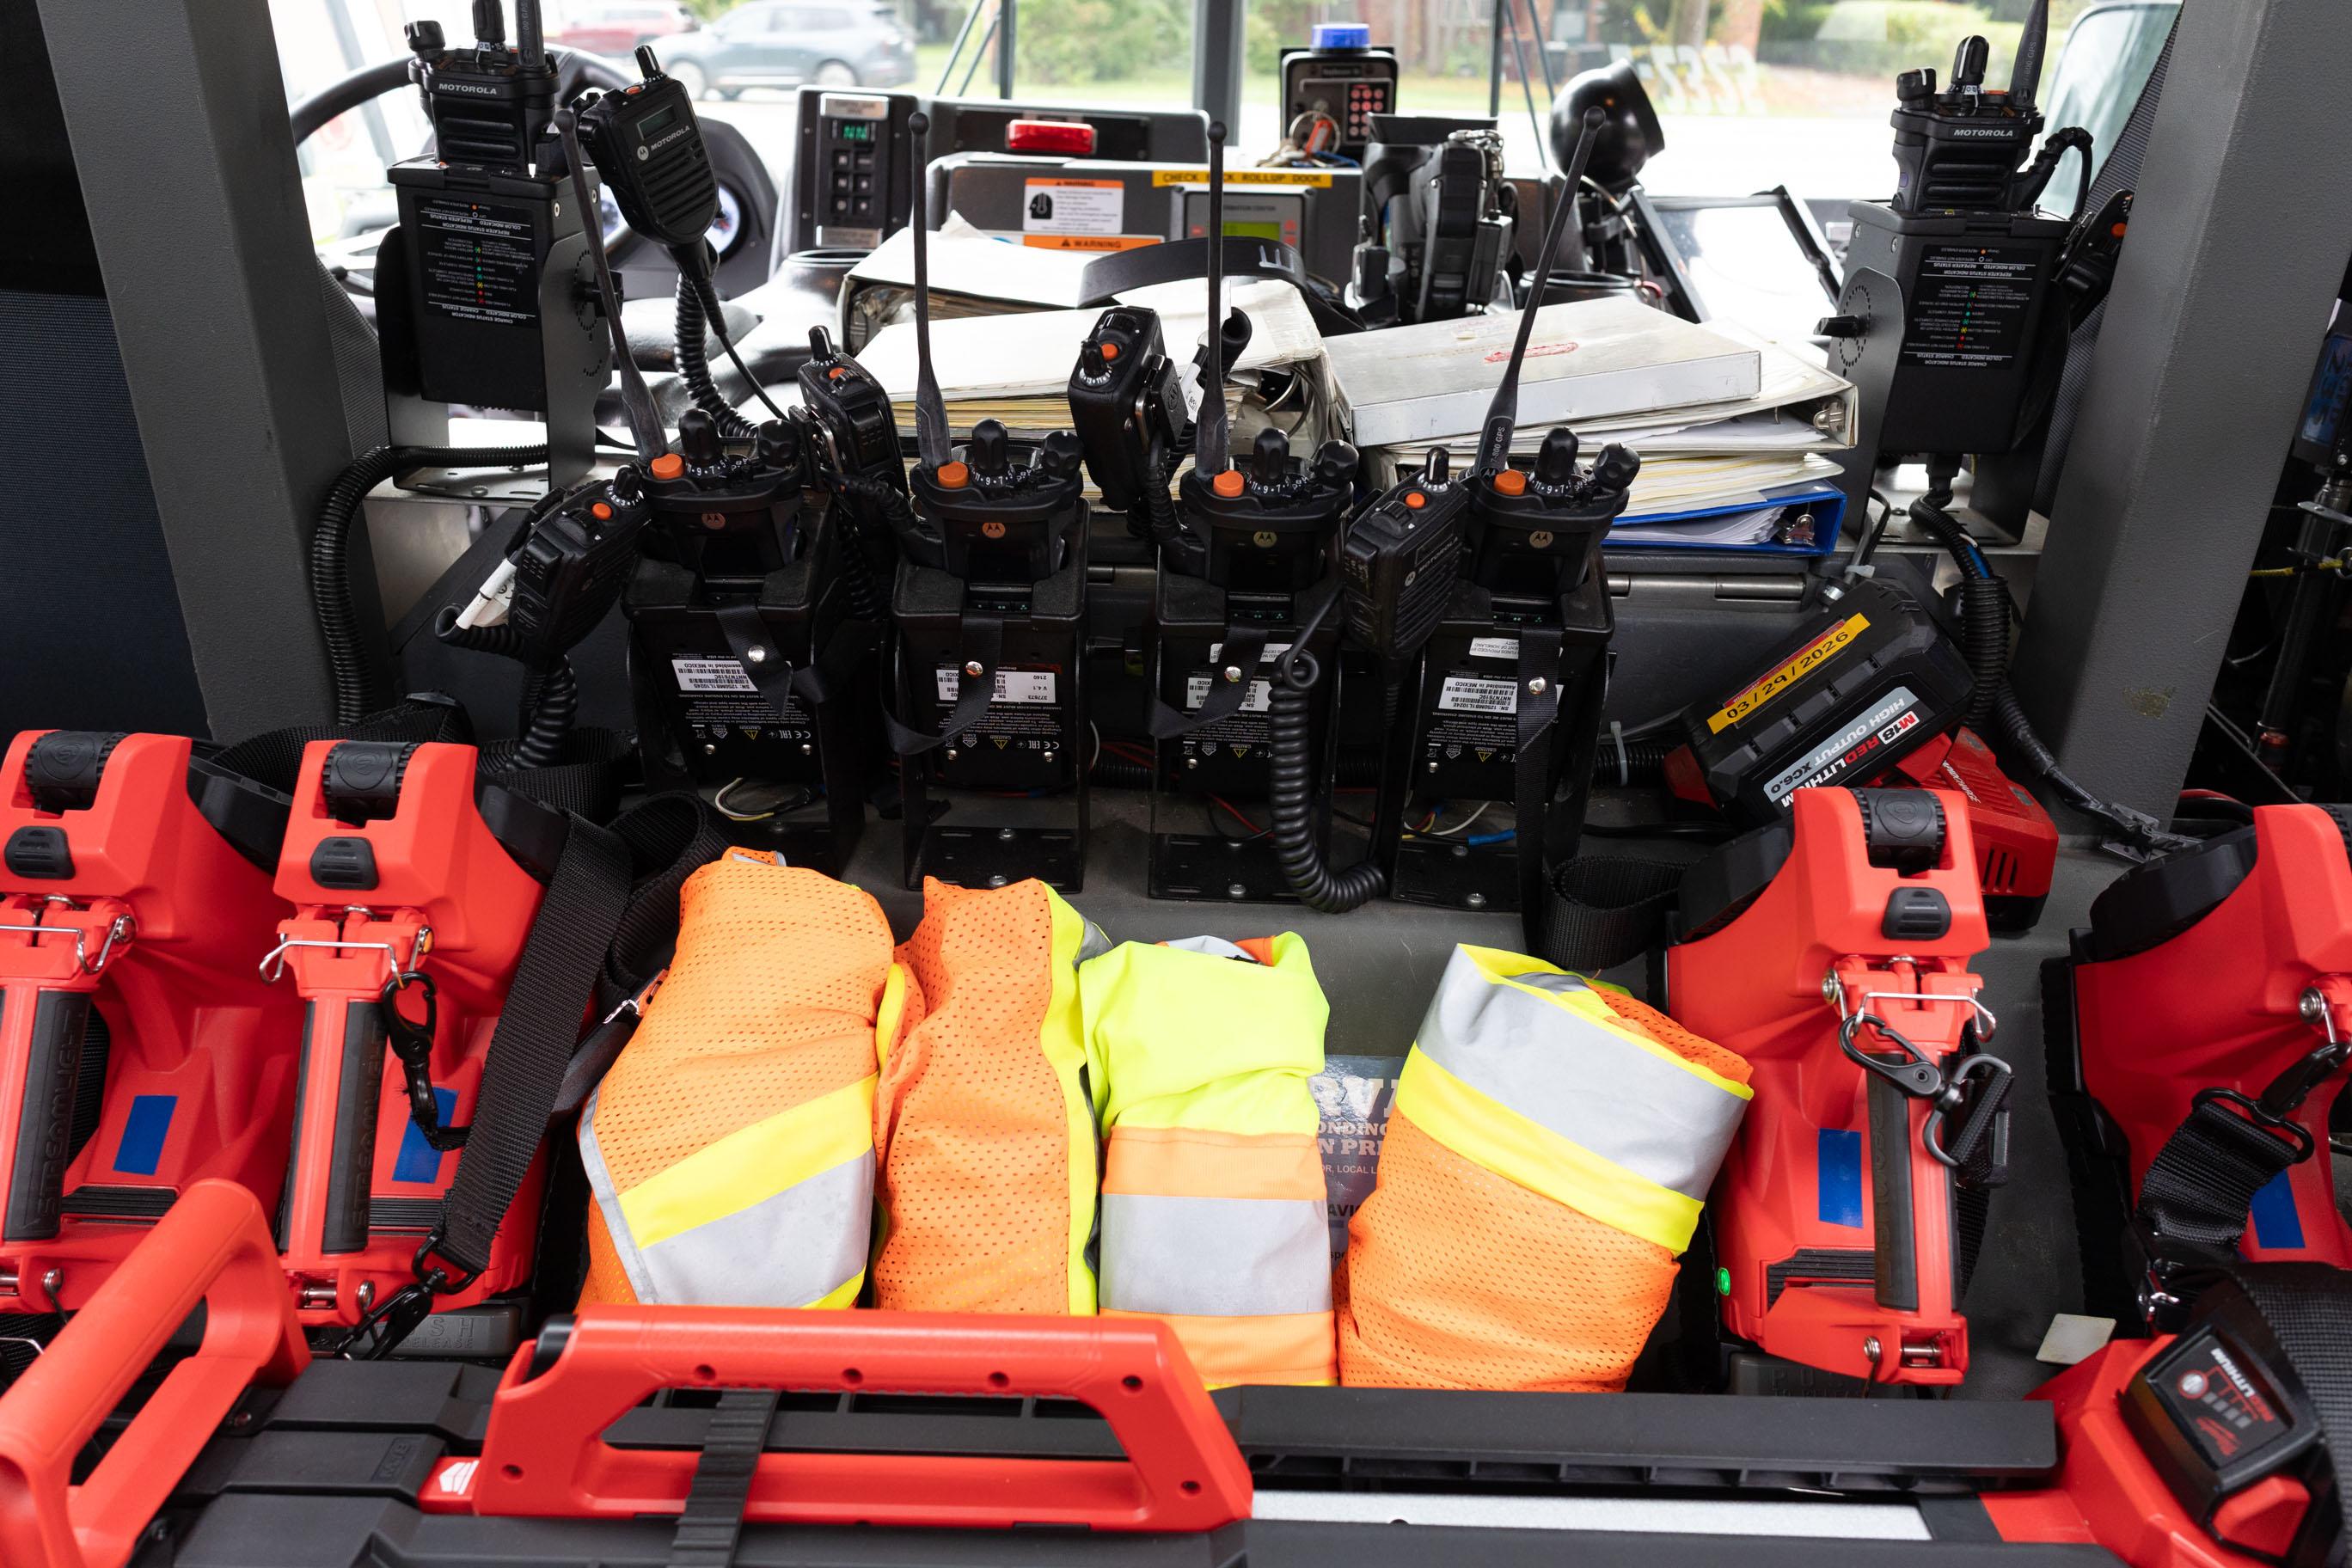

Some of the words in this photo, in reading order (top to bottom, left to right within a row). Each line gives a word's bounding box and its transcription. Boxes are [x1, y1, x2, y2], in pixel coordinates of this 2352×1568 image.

[438, 83, 496, 95] MOTOROLA
[651, 126, 690, 150] MOTOROLA
[1242, 174, 1285, 182] ROLLUP
[1496, 426, 1505, 443] GPS
[709, 466, 715, 475] 7
[1252, 481, 1258, 490] 11
[1277, 484, 1281, 493] 7
[1534, 481, 1541, 490] 11
[1559, 485, 1564, 493] 7
[1869, 698, 1905, 726] HIGH
[1882, 714, 1916, 741] M18
[1814, 725, 1867, 766] OUTPUT
[1770, 761, 1812, 793] XC6.0
[1338, 1165, 1369, 1173] LOCAL
